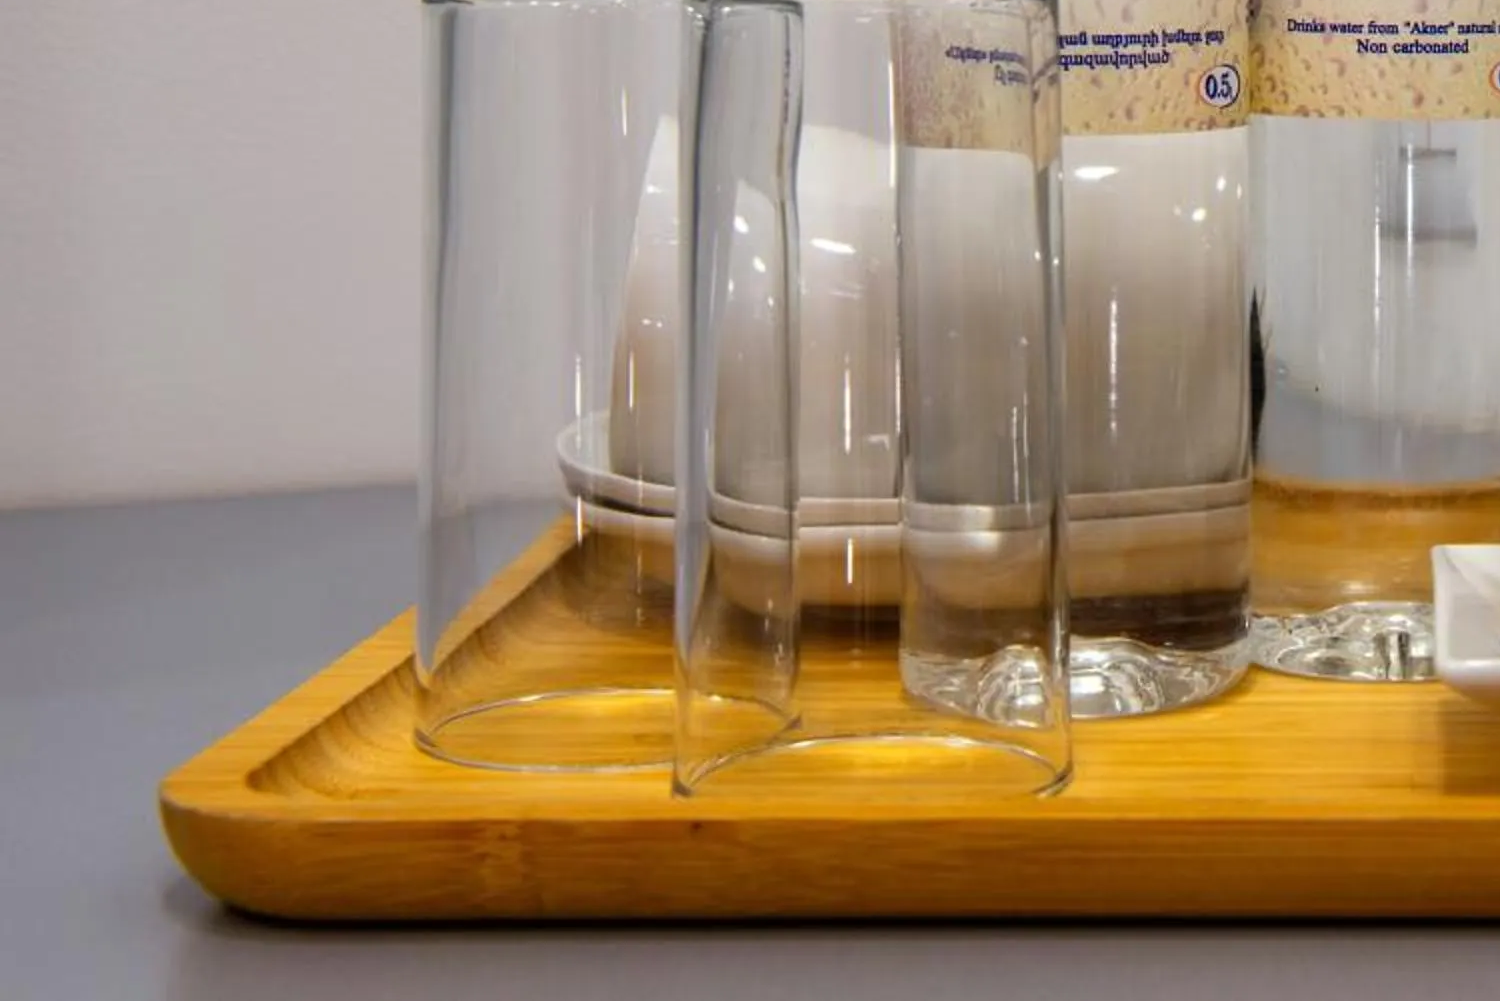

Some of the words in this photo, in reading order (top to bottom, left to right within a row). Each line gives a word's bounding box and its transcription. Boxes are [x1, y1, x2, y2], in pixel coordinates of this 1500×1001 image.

[1287, 18, 1326, 34] Drinks
[1329, 21, 1364, 34] water
[1367, 20, 1400, 35] from
[1457, 20, 1497, 35] natural
[1357, 39, 1388, 54] Non
[1392, 39, 1470, 55] carbonated
